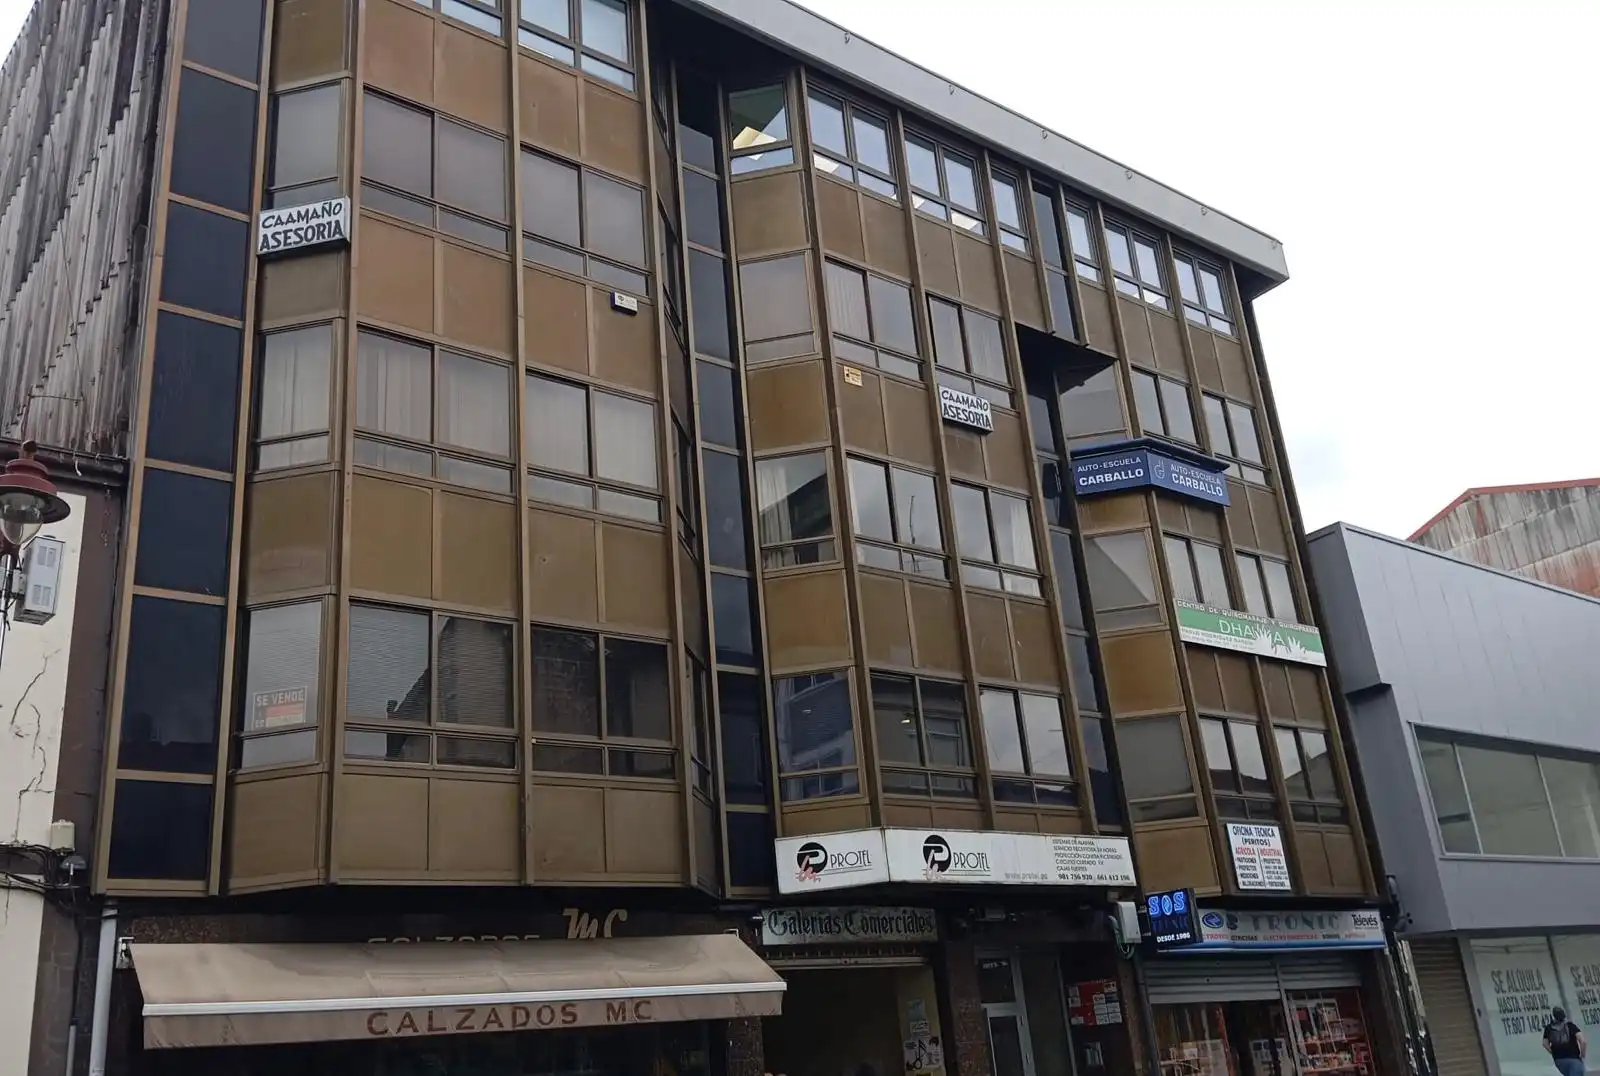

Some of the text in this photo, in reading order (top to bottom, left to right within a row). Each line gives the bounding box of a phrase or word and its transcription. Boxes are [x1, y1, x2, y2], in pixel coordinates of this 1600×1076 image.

[262, 201, 342, 229] CAAMAÑO
[260, 220, 344, 251] ASESORIA
[942, 390, 988, 412] CAAMAÑO
[943, 402, 992, 429] ASESORIA
[1079, 468, 1144, 486] CARBALLO
[1172, 473, 1223, 497] CARBALLO
[1177, 600, 1206, 612] CENTRO
[1208, 606, 1218, 614] DE
[256, 689, 304, 706] SE VENDE
[1232, 826, 1254, 836] OFICINA
[830, 850, 872, 869] PROTEL
[953, 852, 990, 870] PROTEL
[1148, 891, 1185, 916] SOS
[844, 908, 933, 936] Comerciales
[1250, 912, 1340, 931] TRONIC
[1351, 914, 1378, 927] Televés
[1156, 933, 1175, 943] DESDE
[1490, 968, 1546, 994] SE ALQUILA
[1570, 966, 1584, 988] SE
[1496, 996, 1522, 1014] HASTA
[366, 1000, 654, 1036] CALZADOS MC
